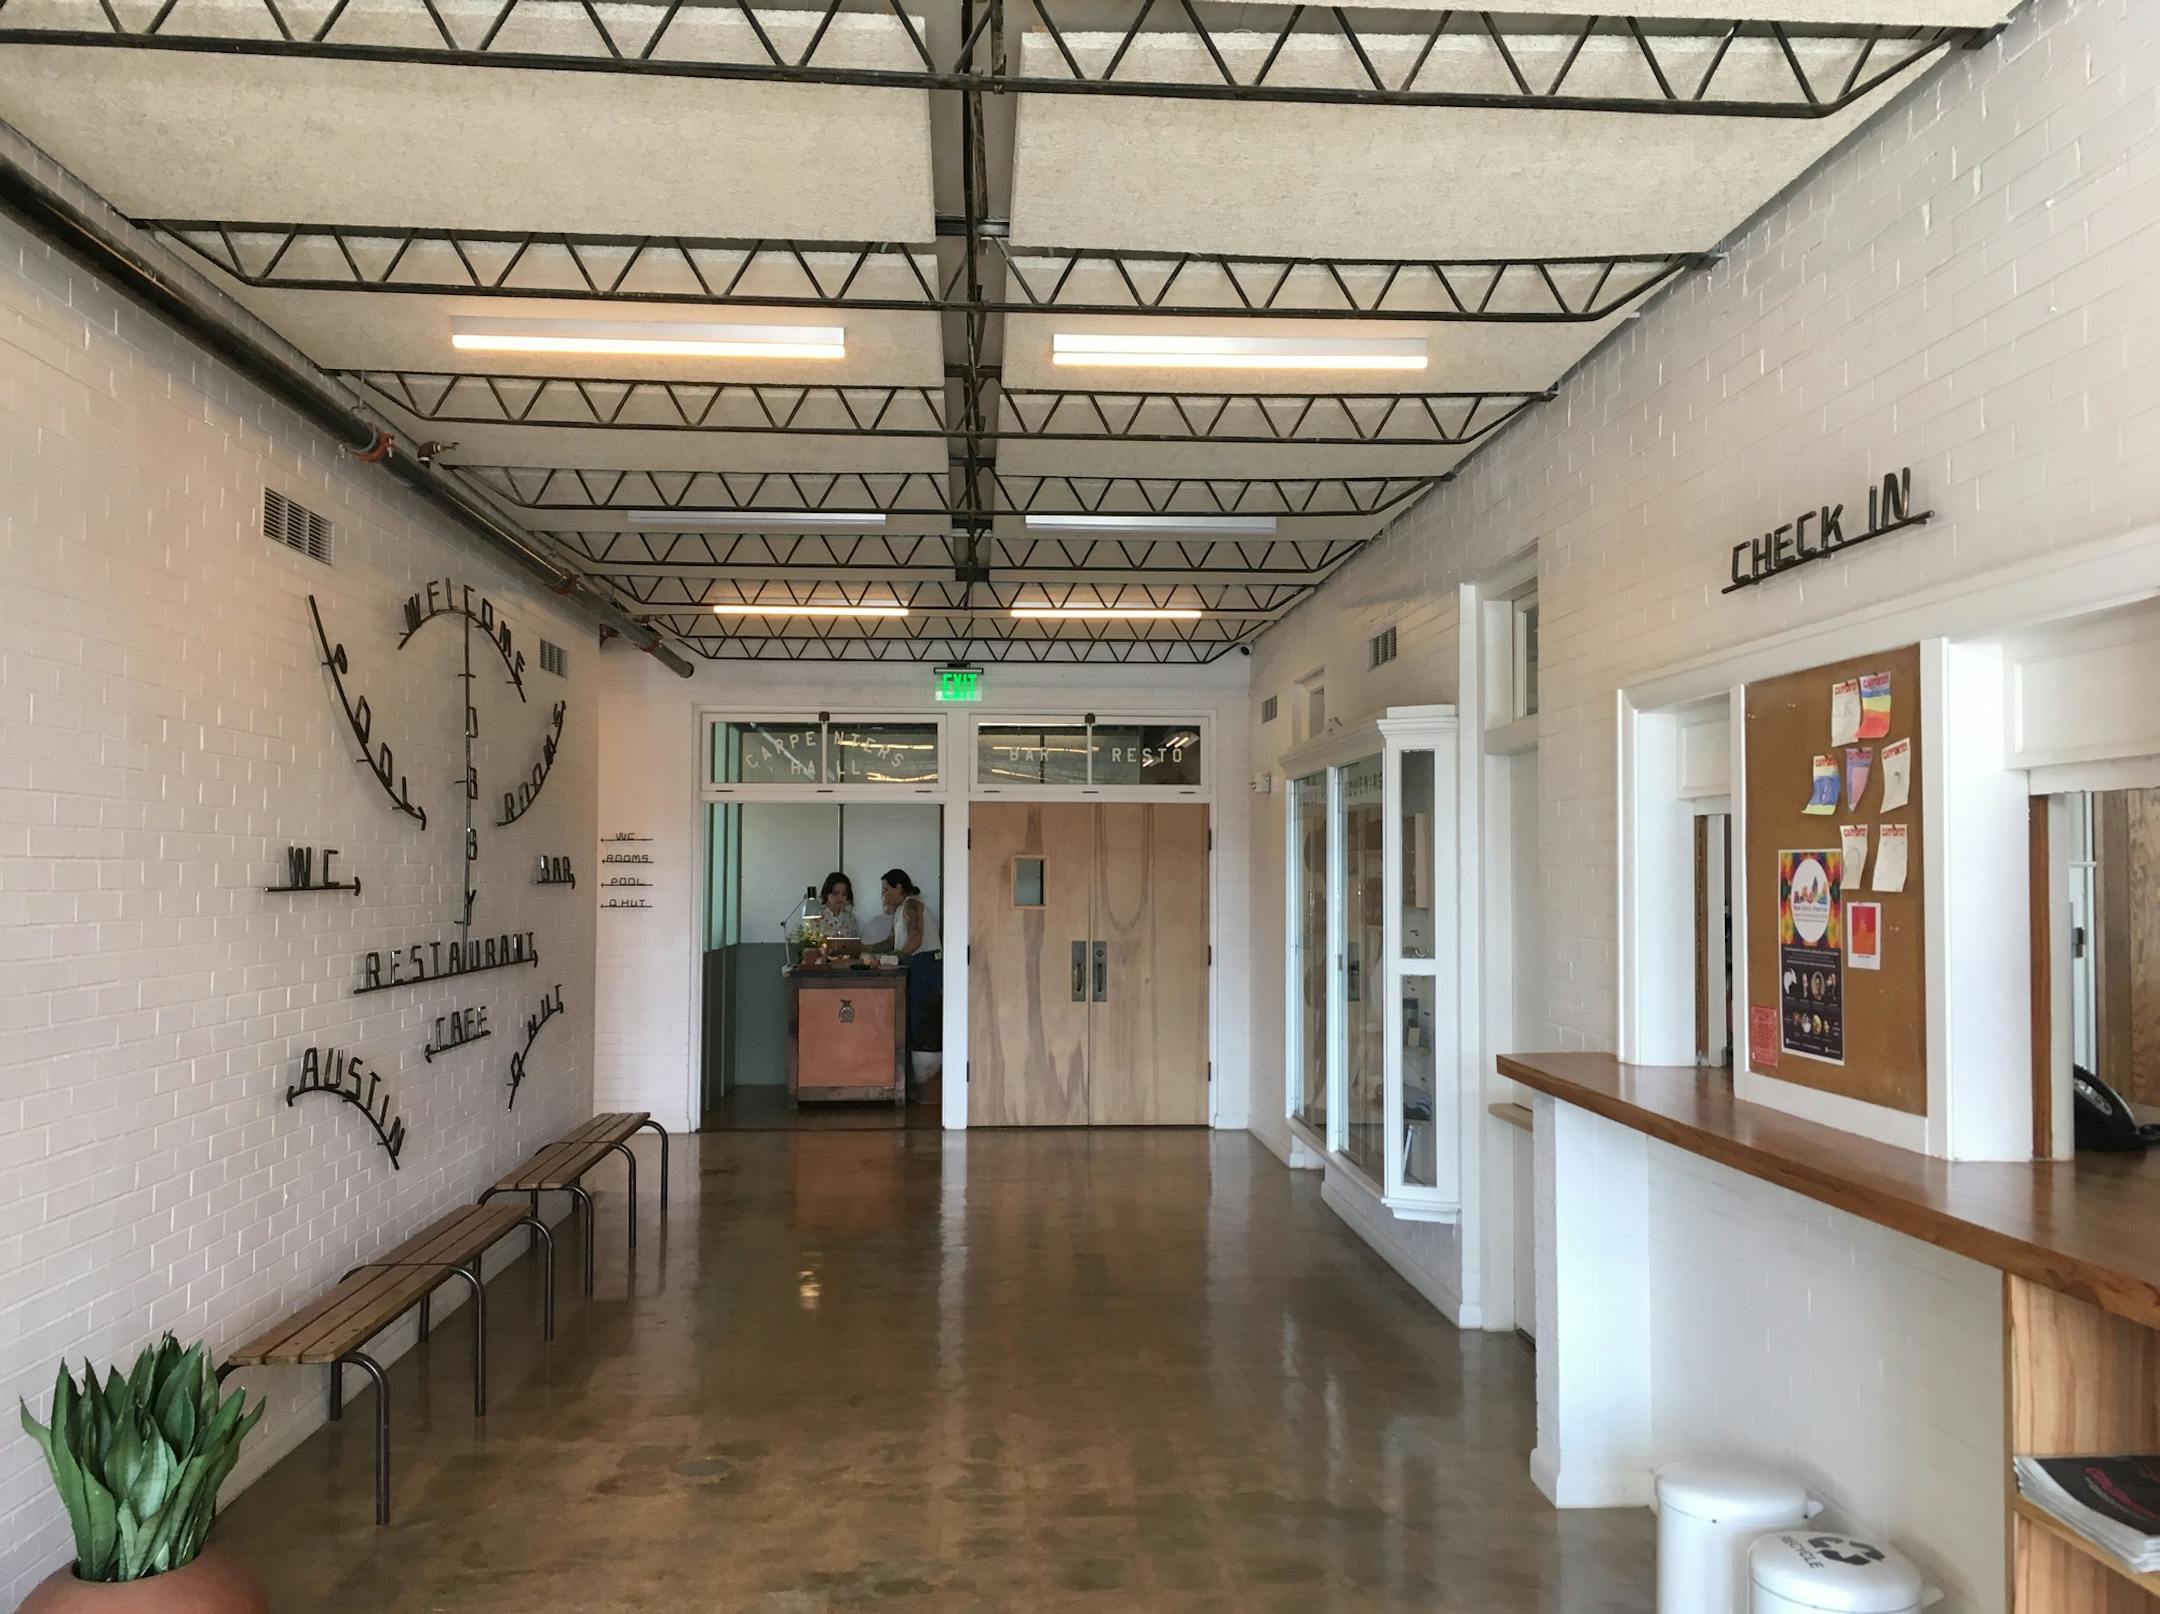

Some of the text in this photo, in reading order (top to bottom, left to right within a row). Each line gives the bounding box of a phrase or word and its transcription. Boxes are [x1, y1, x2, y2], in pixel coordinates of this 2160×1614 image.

[1732, 467, 1911, 584] CHECK IN
[404, 577, 525, 686] WELCOME
[943, 673, 977, 699] EXIT
[327, 643, 416, 814] POOL
[505, 702, 562, 822] ROOMS
[745, 731, 905, 768] CARPENTERS
[791, 760, 862, 775] HALL
[1009, 748, 1184, 764] BAR RESTO
[615, 832, 636, 841] WC
[288, 846, 339, 888] WC
[540, 855, 573, 882] BAR
[606, 854, 649, 864] ROOMS
[611, 877, 644, 887] POOL
[621, 899, 646, 907] HUT
[366, 932, 534, 988] RESTAURANT
[435, 1006, 488, 1051] CAFE
[527, 984, 563, 1042] HUT
[301, 1048, 405, 1157] AUSTIN
